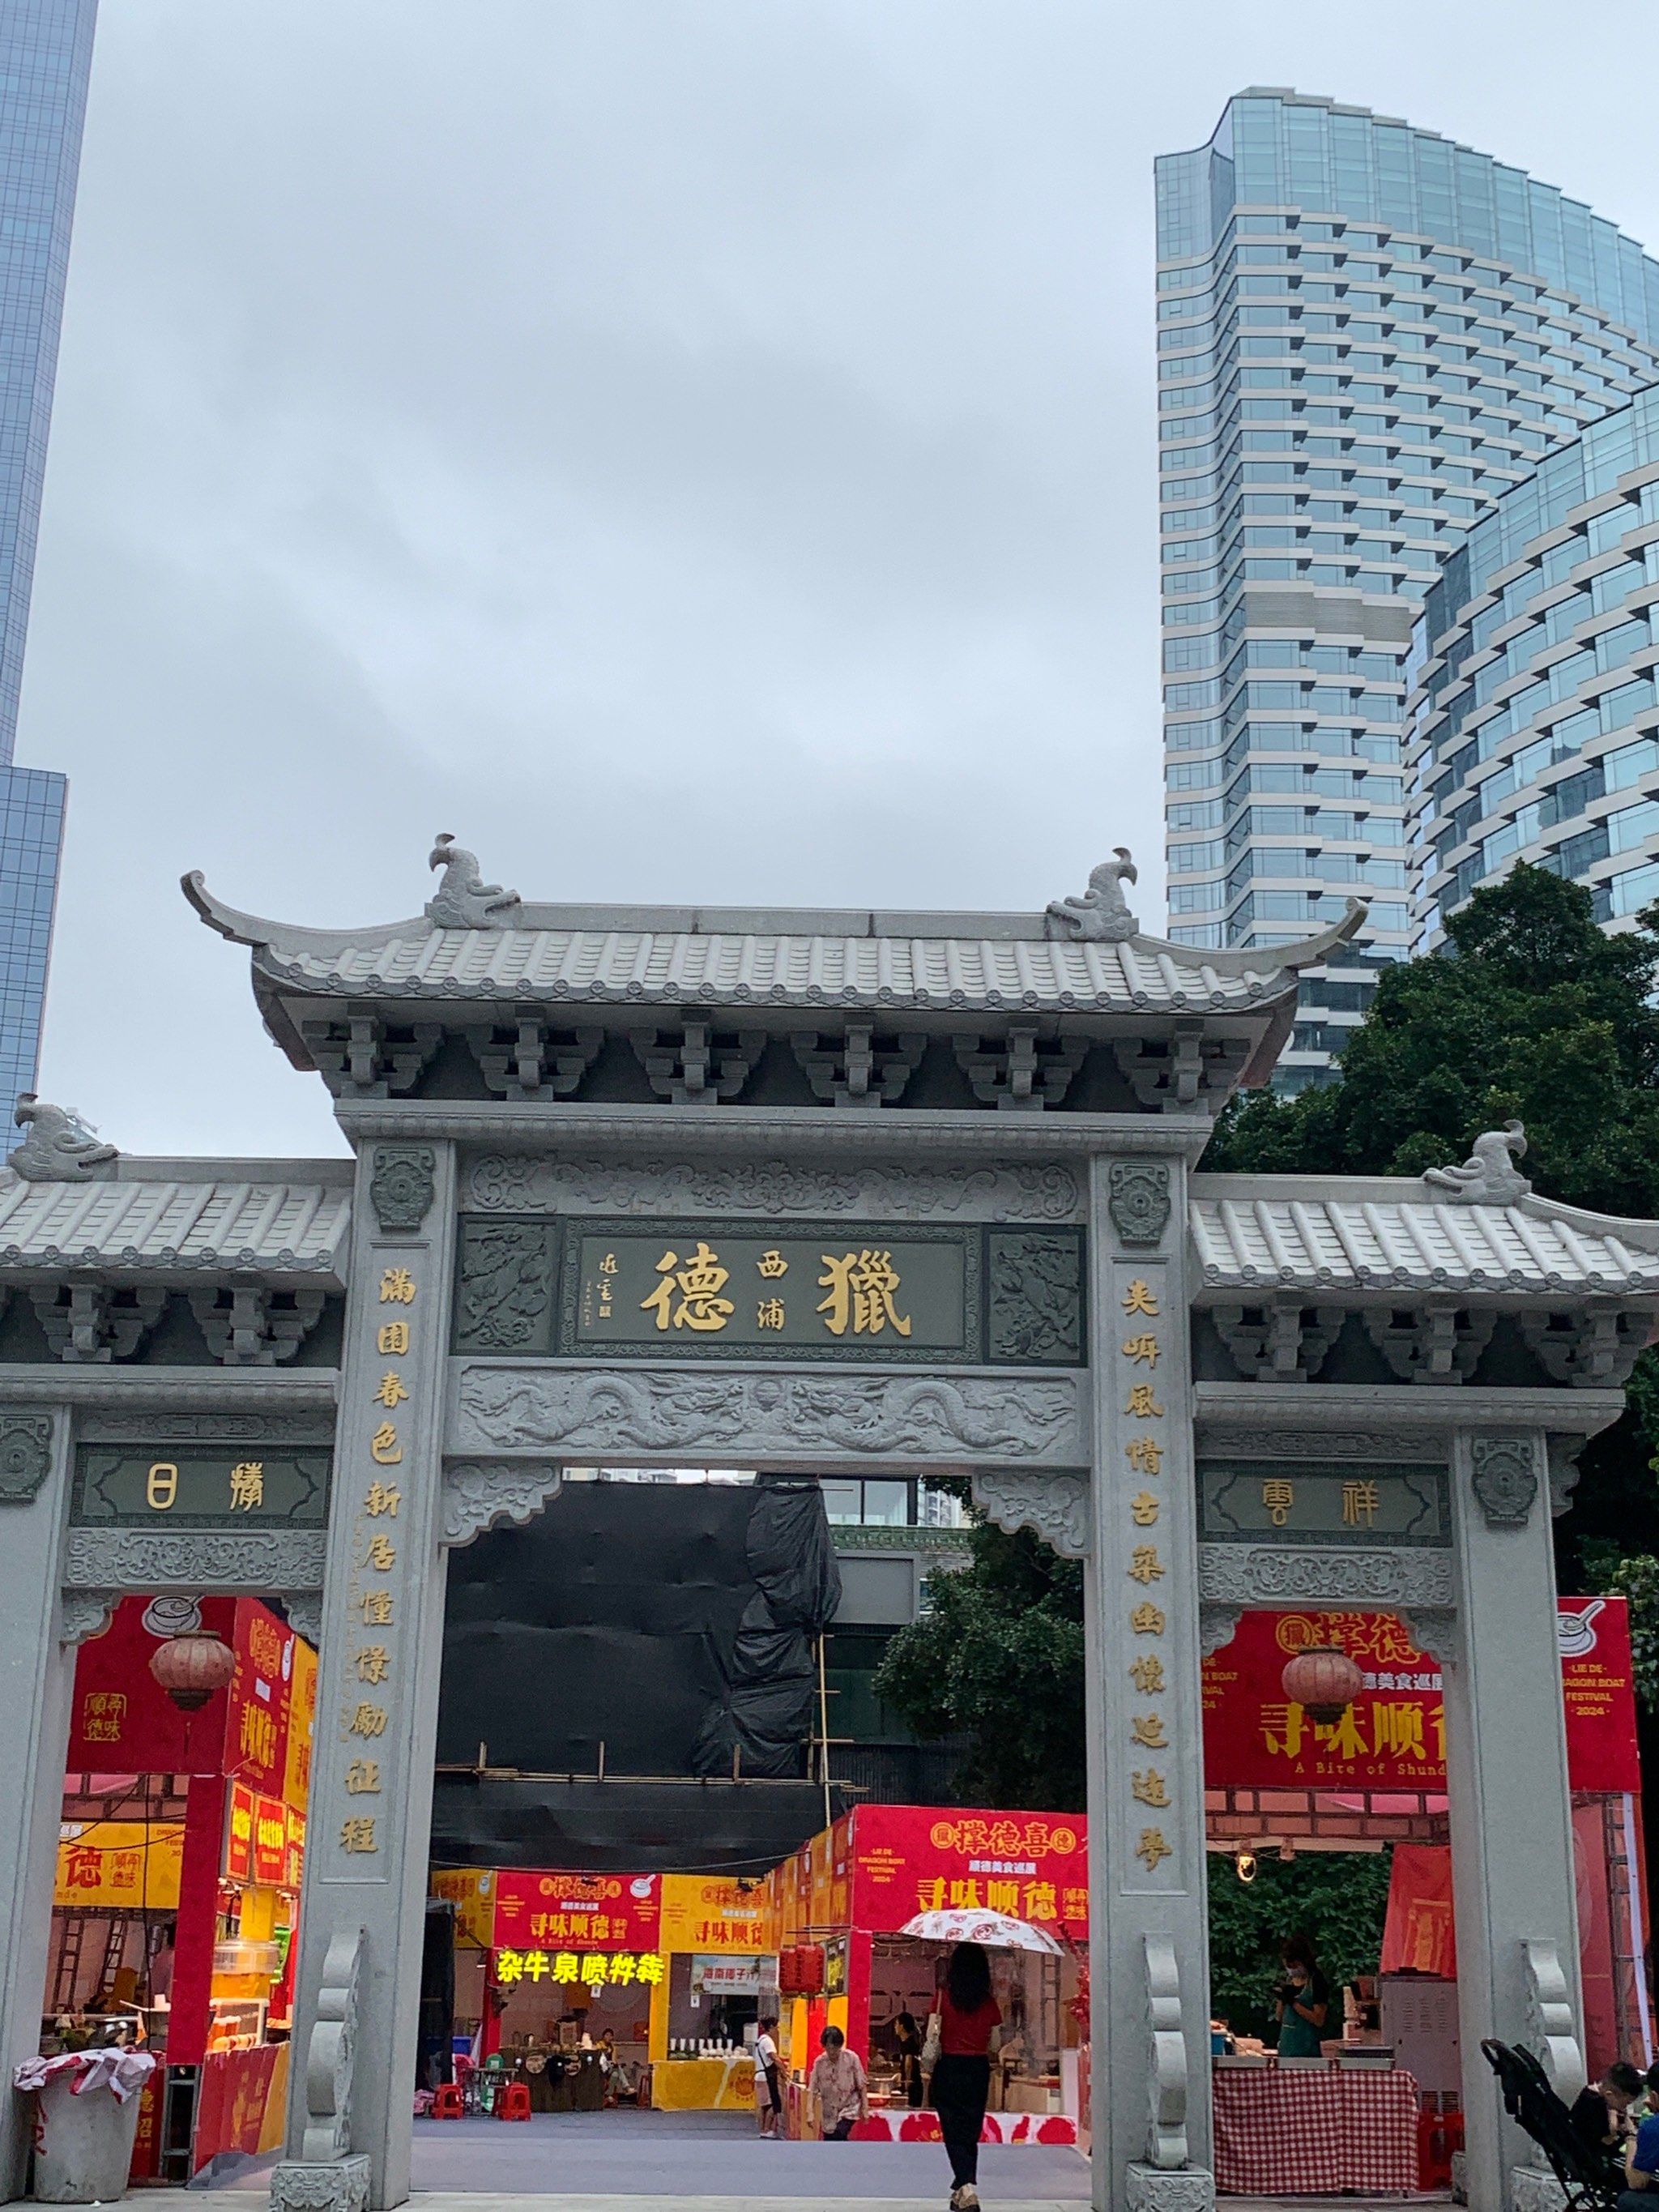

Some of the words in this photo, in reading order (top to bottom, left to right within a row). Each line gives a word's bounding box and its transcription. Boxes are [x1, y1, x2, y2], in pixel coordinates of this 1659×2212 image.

[756, 1250, 789, 1330] 西浦
[1566, 1692, 1614, 1702] FESTIVAL
[1295, 1762, 1305, 1774] A
[1316, 1763, 1355, 1774] Bite
[1367, 1764, 1386, 1774] of
[1397, 1764, 1447, 1776] Shund
[915, 1875, 1058, 1921] 寻味顺德
[530, 1912, 610, 1940] 寻味顺德
